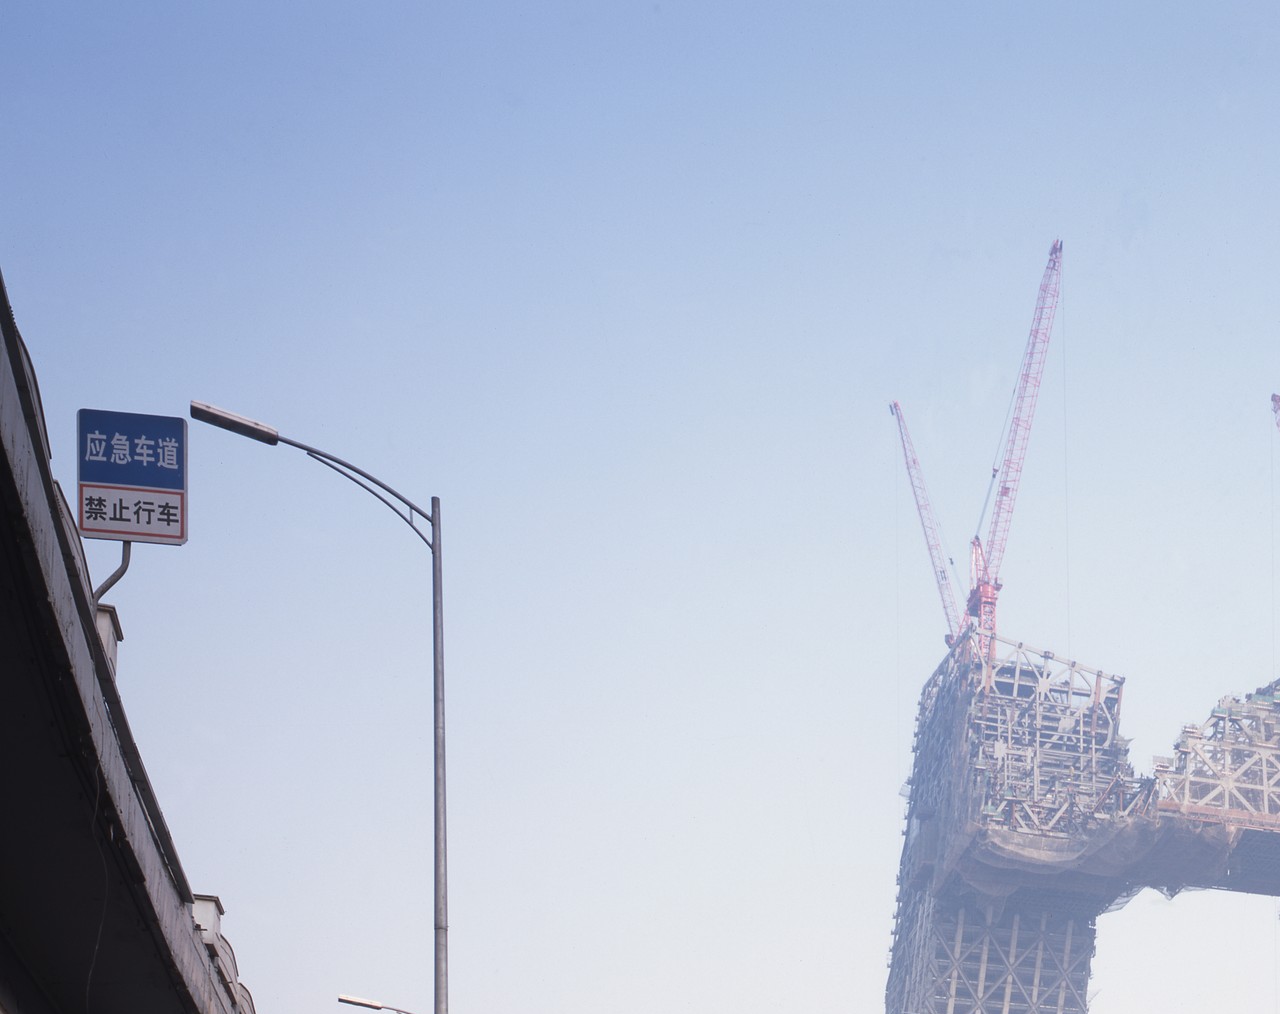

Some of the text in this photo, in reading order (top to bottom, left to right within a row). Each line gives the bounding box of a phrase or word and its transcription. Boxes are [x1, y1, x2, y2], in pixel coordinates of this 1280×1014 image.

[85, 430, 179, 470] 应急车道
[85, 496, 179, 526] 禁止行车
